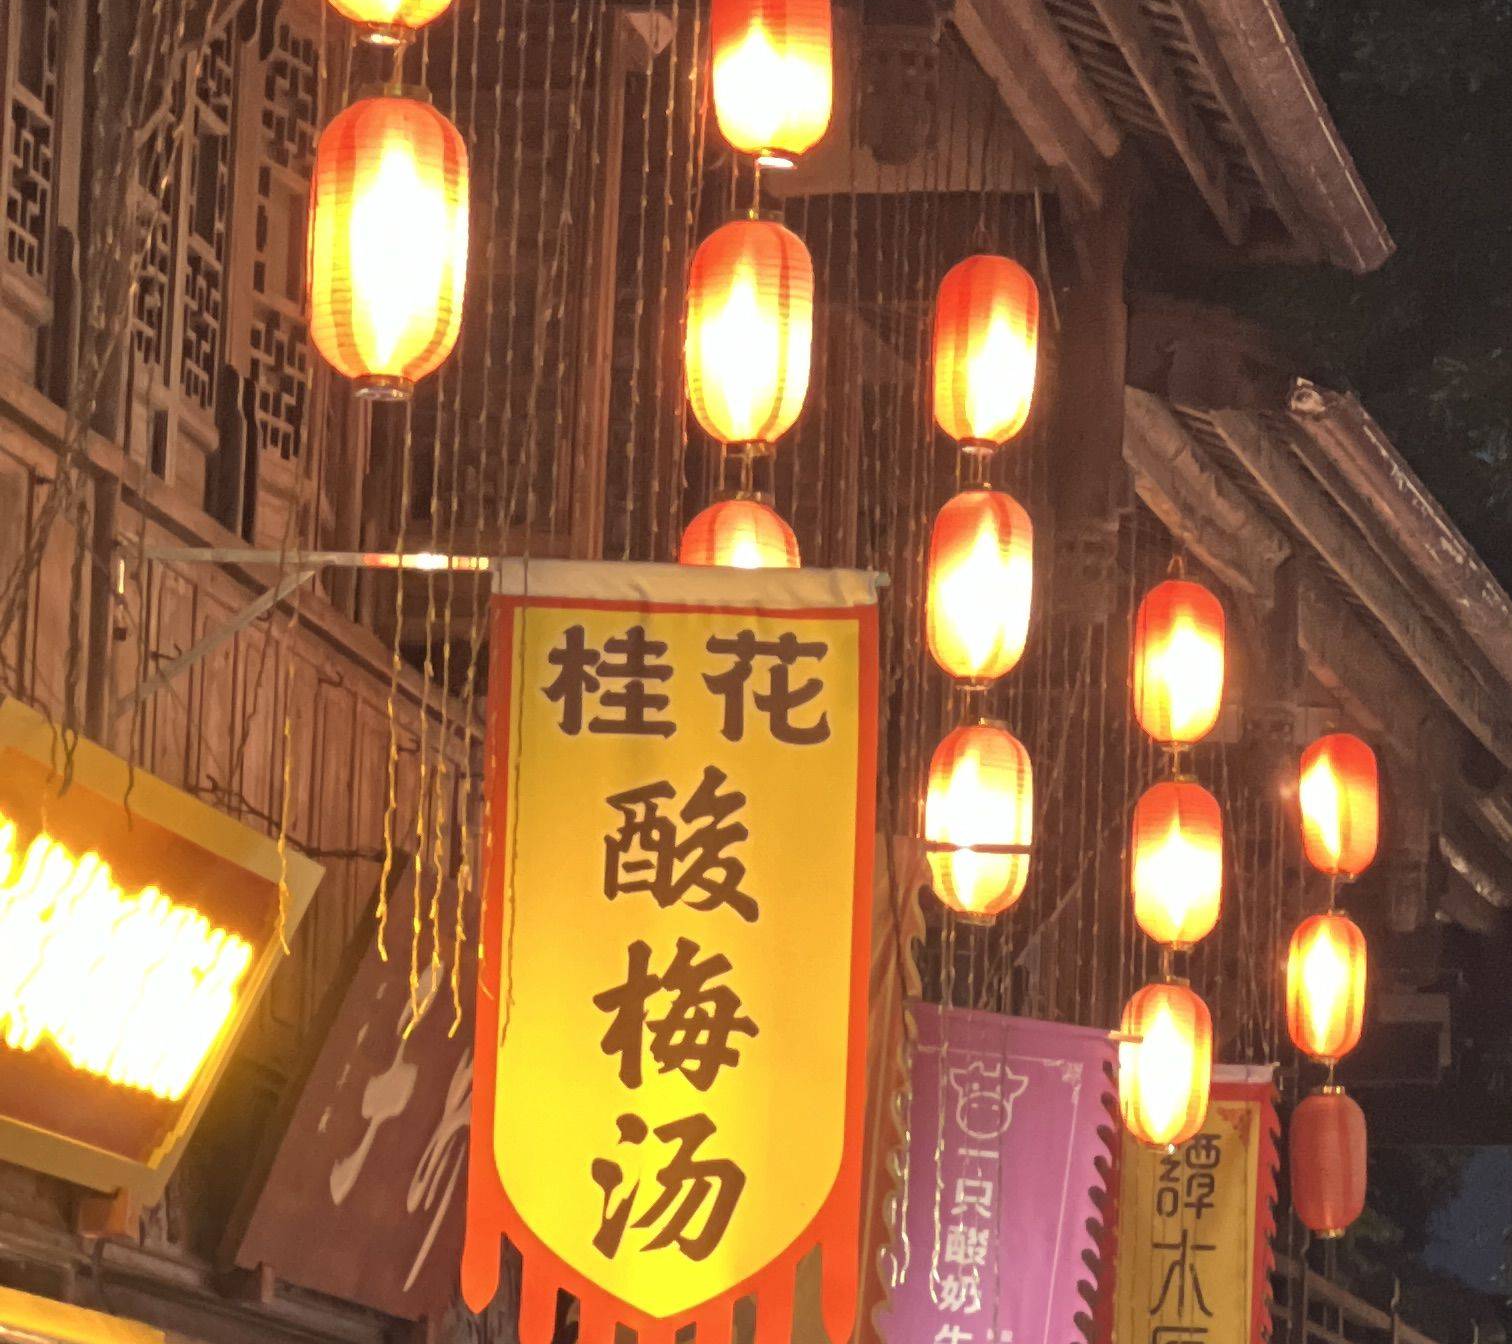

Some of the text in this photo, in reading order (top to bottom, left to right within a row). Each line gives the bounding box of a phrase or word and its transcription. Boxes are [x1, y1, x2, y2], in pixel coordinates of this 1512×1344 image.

[543, 624, 831, 745] 桂花
[592, 764, 760, 1262] 酸梅汤
